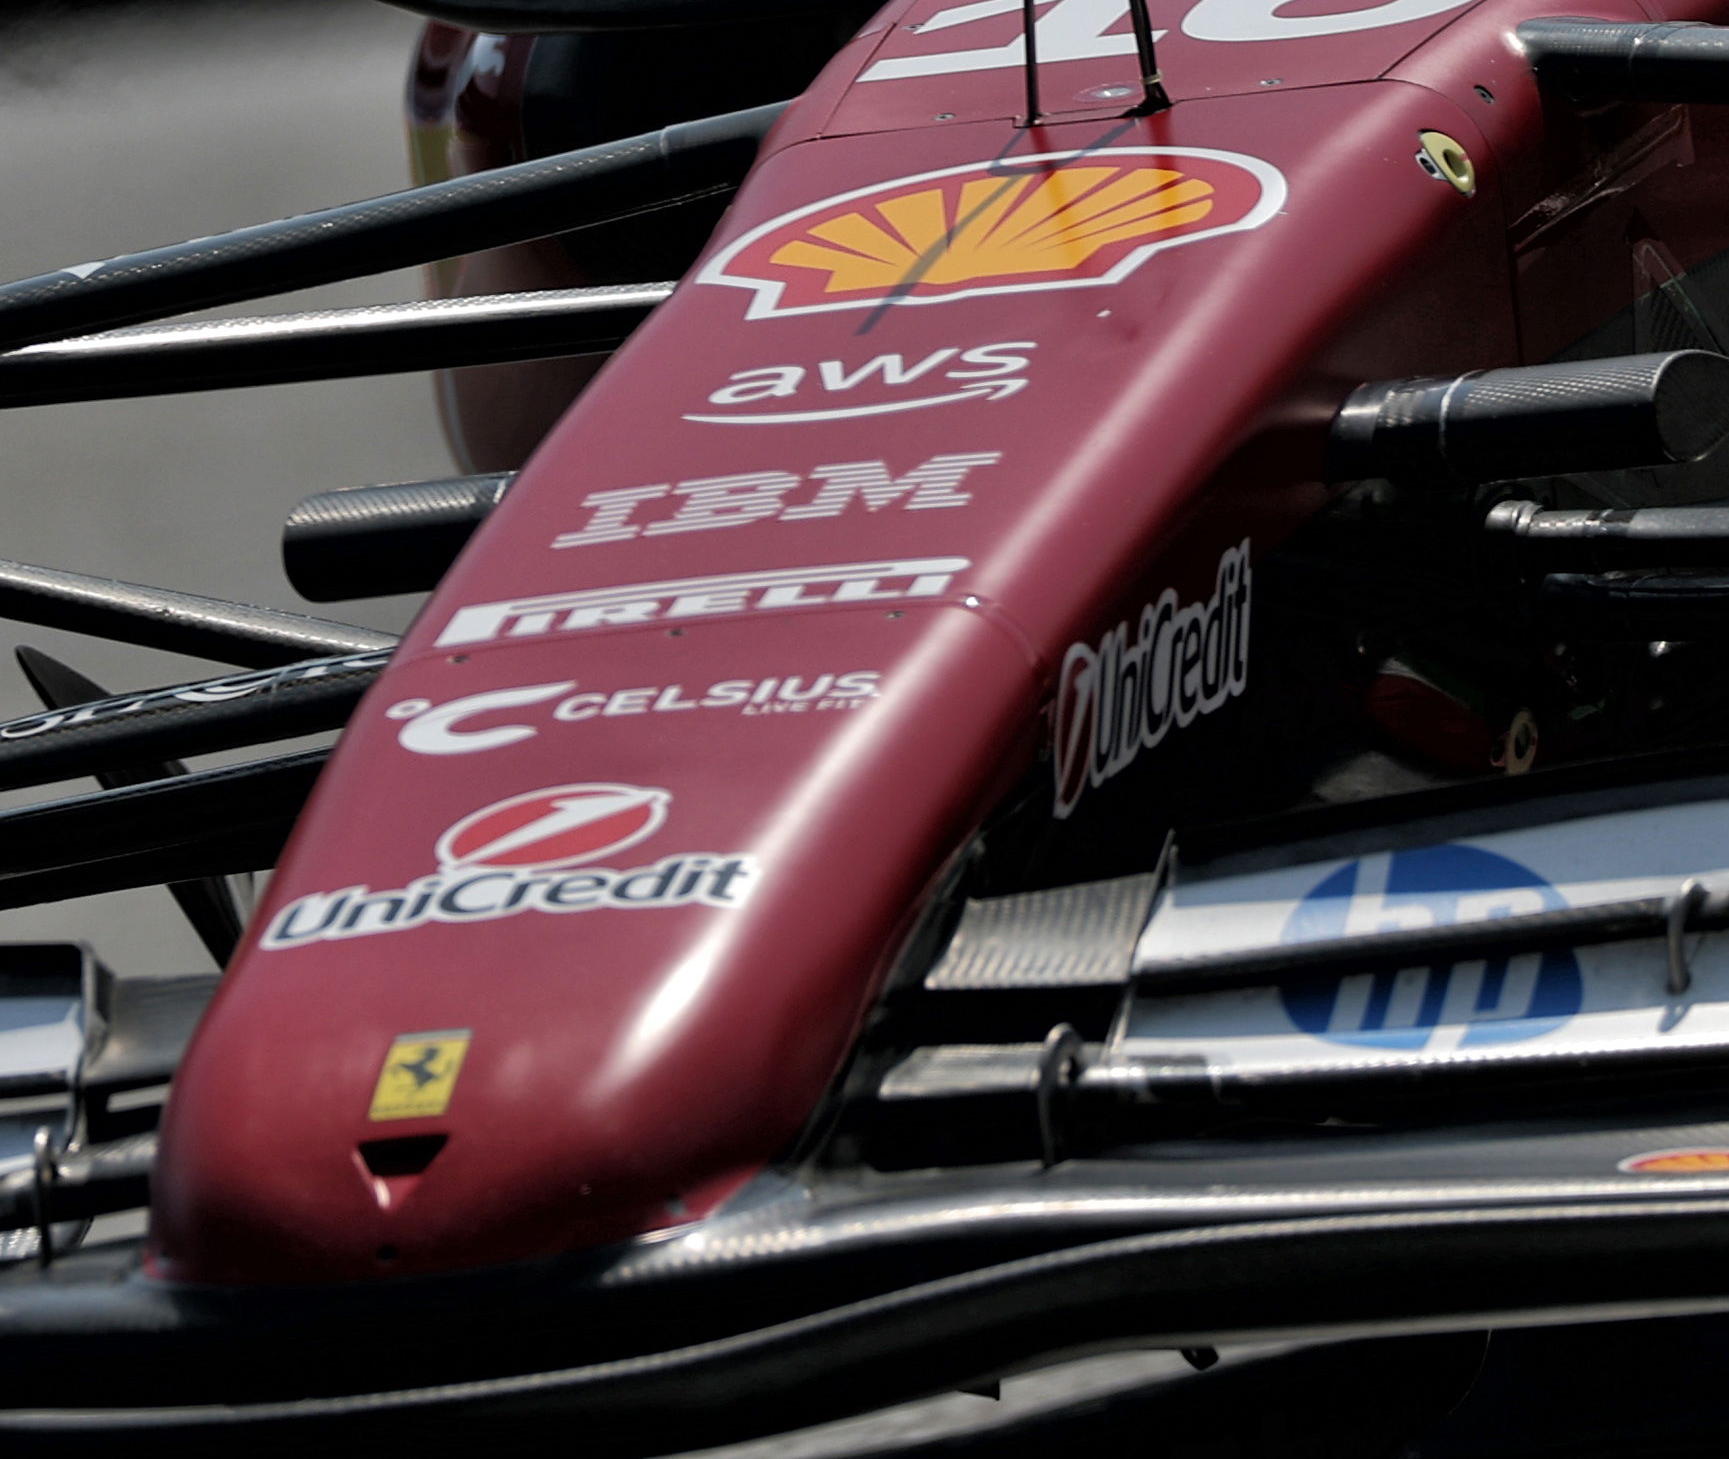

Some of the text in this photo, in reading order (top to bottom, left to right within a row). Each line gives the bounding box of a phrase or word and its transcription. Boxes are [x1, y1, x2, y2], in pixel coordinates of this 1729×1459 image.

[708, 341, 1037, 406] aws
[550, 451, 1003, 550] IBM
[434, 557, 970, 649] PIRELLI
[552, 670, 882, 723] CELSIUS
[741, 702, 810, 717] LIVE
[1093, 552, 1250, 780] UniCredit
[273, 858, 752, 945] UniCredit
